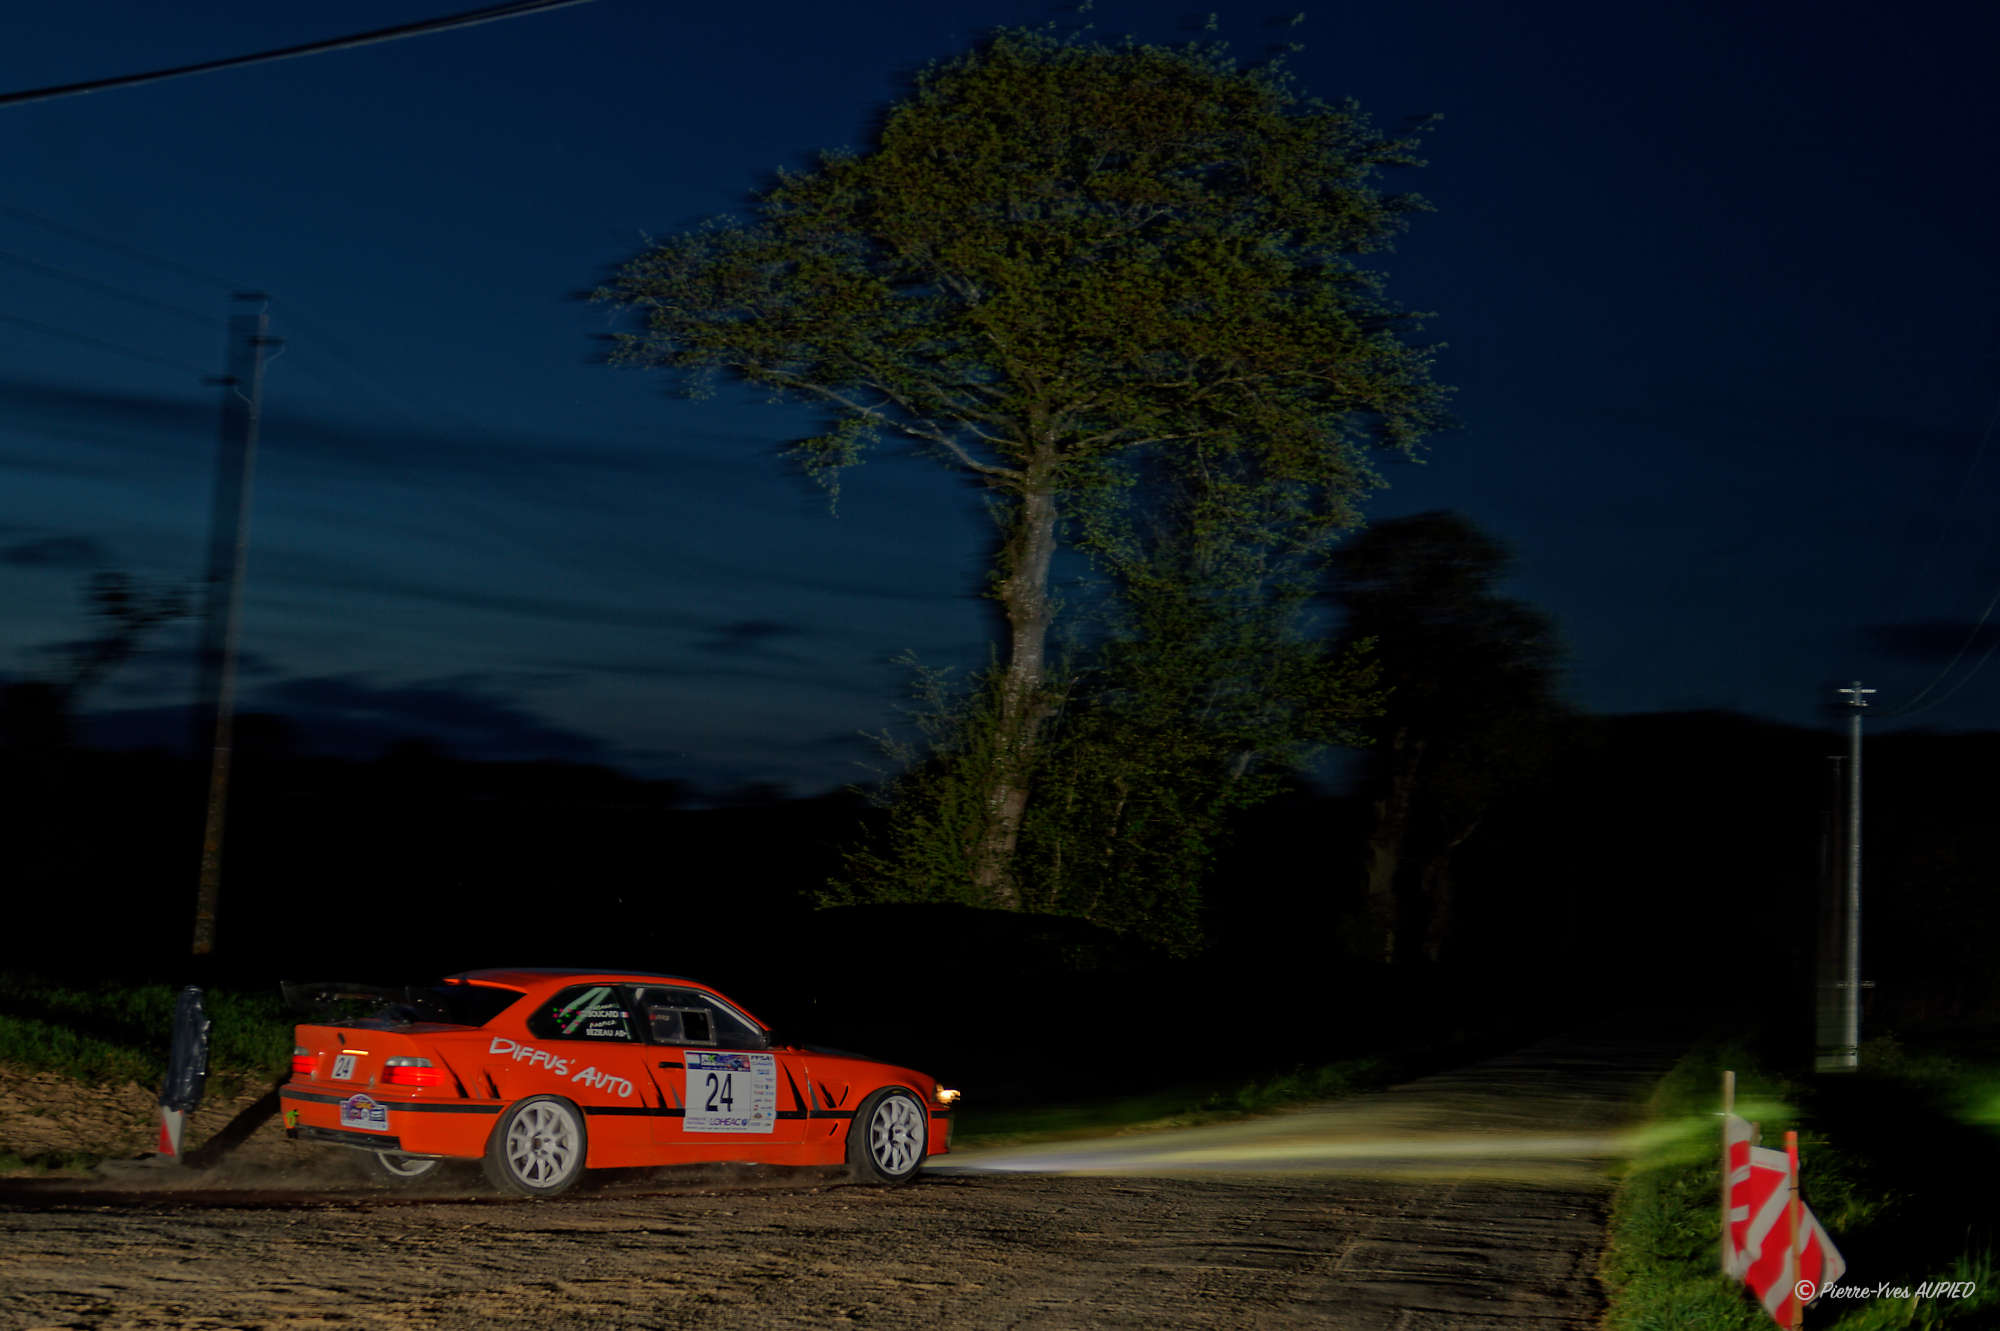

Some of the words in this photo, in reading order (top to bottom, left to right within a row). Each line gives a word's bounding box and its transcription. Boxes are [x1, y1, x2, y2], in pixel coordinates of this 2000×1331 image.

[334, 1056, 351, 1078] 24
[571, 1066, 633, 1098] AUTO
[705, 1073, 733, 1112] 24
